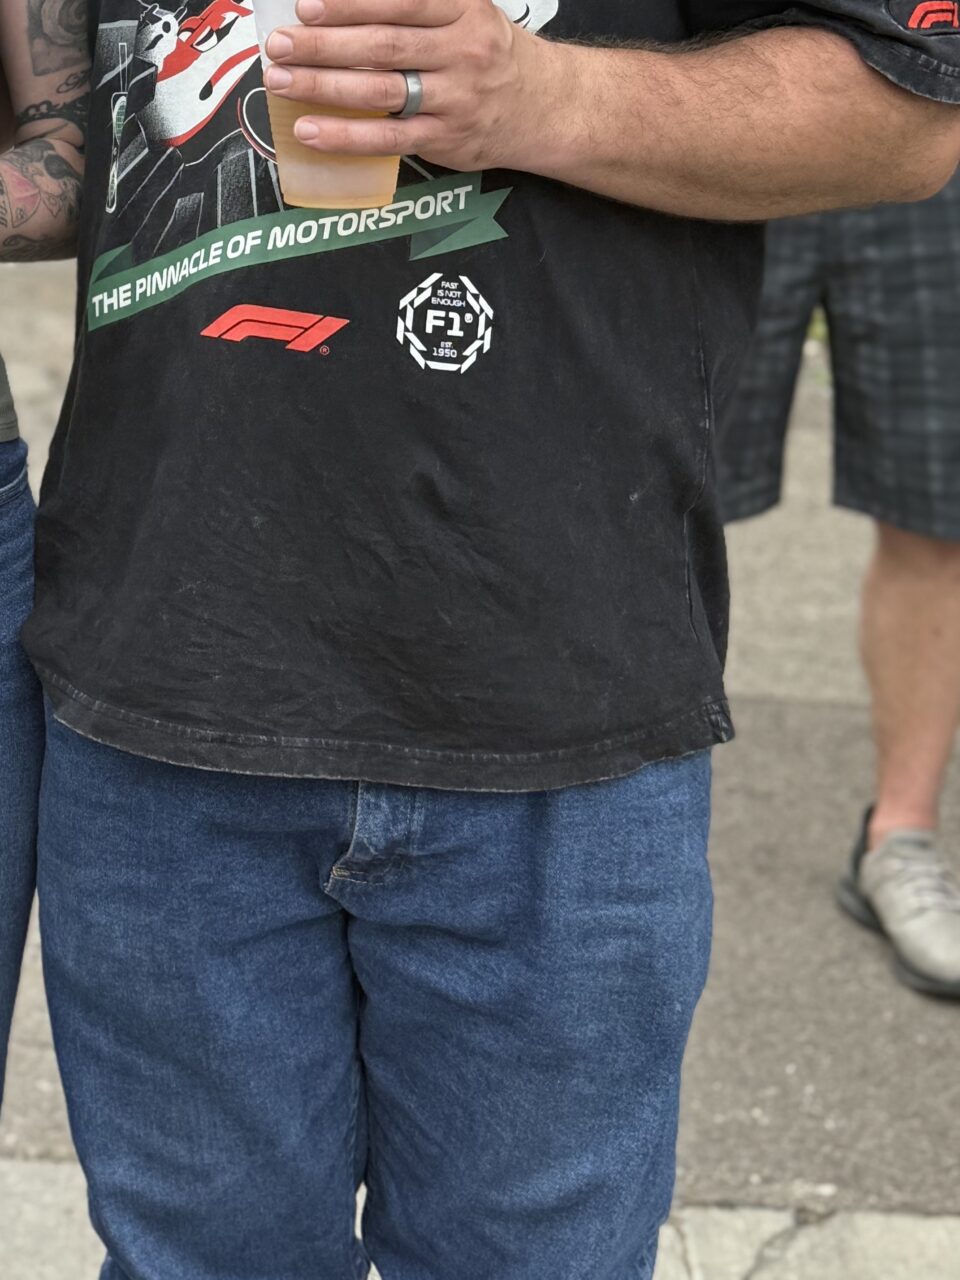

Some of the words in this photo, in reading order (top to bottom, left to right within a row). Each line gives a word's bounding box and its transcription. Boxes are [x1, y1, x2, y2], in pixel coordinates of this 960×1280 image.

[92, 283, 132, 318] THE
[135, 240, 224, 302] PINNACLE
[226, 229, 263, 259] OF
[266, 185, 473, 251] MOTORSPORT
[440, 281, 459, 289] FAST
[437, 289, 444, 297] IS
[445, 290, 462, 298] NOT
[431, 297, 466, 308] ENOUGH
[432, 347, 458, 358] 1950
